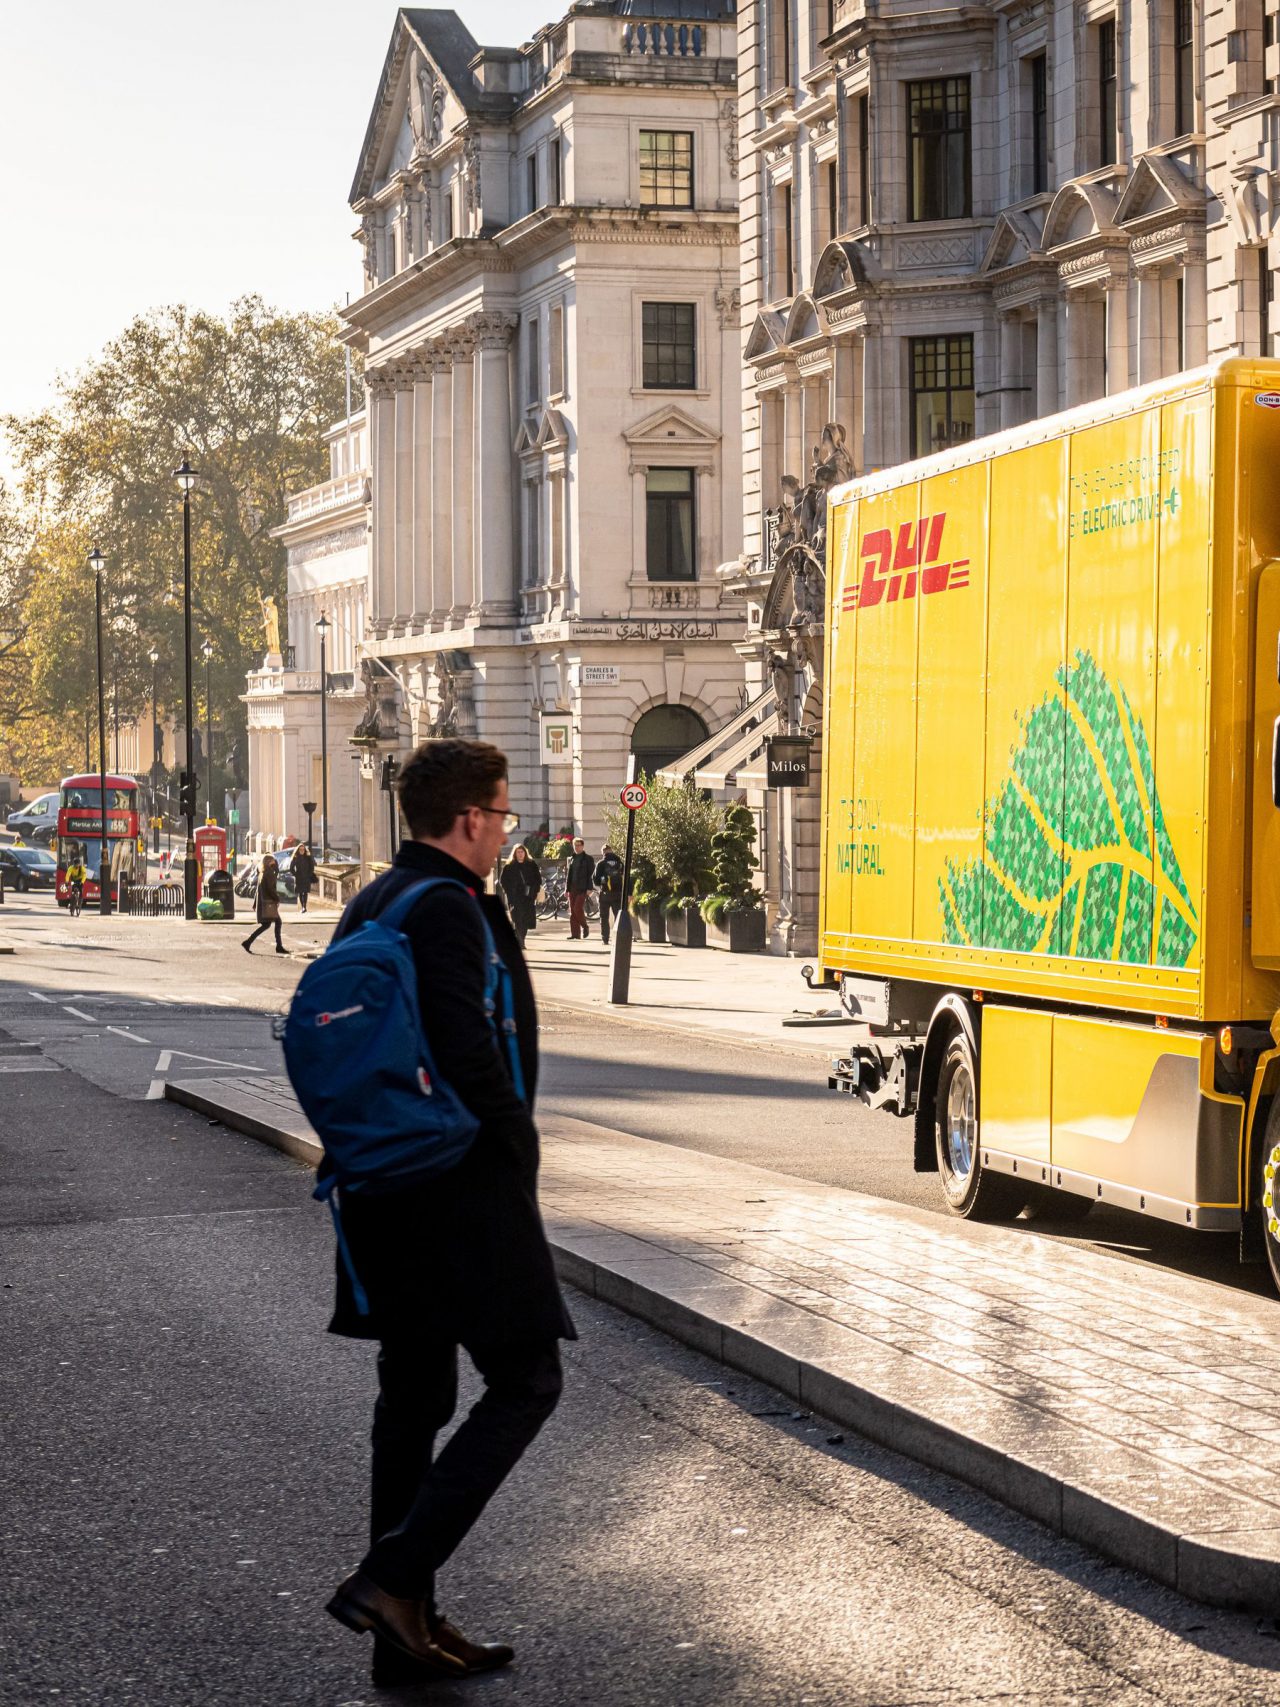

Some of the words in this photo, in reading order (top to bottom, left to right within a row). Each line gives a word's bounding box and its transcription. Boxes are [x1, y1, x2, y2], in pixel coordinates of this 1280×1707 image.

[1083, 501, 1127, 534] ELECTRIC
[1130, 493, 1162, 524] DRIVE
[858, 512, 951, 609] DHL
[771, 760, 806, 772] Milos
[626, 791, 644, 802] 20
